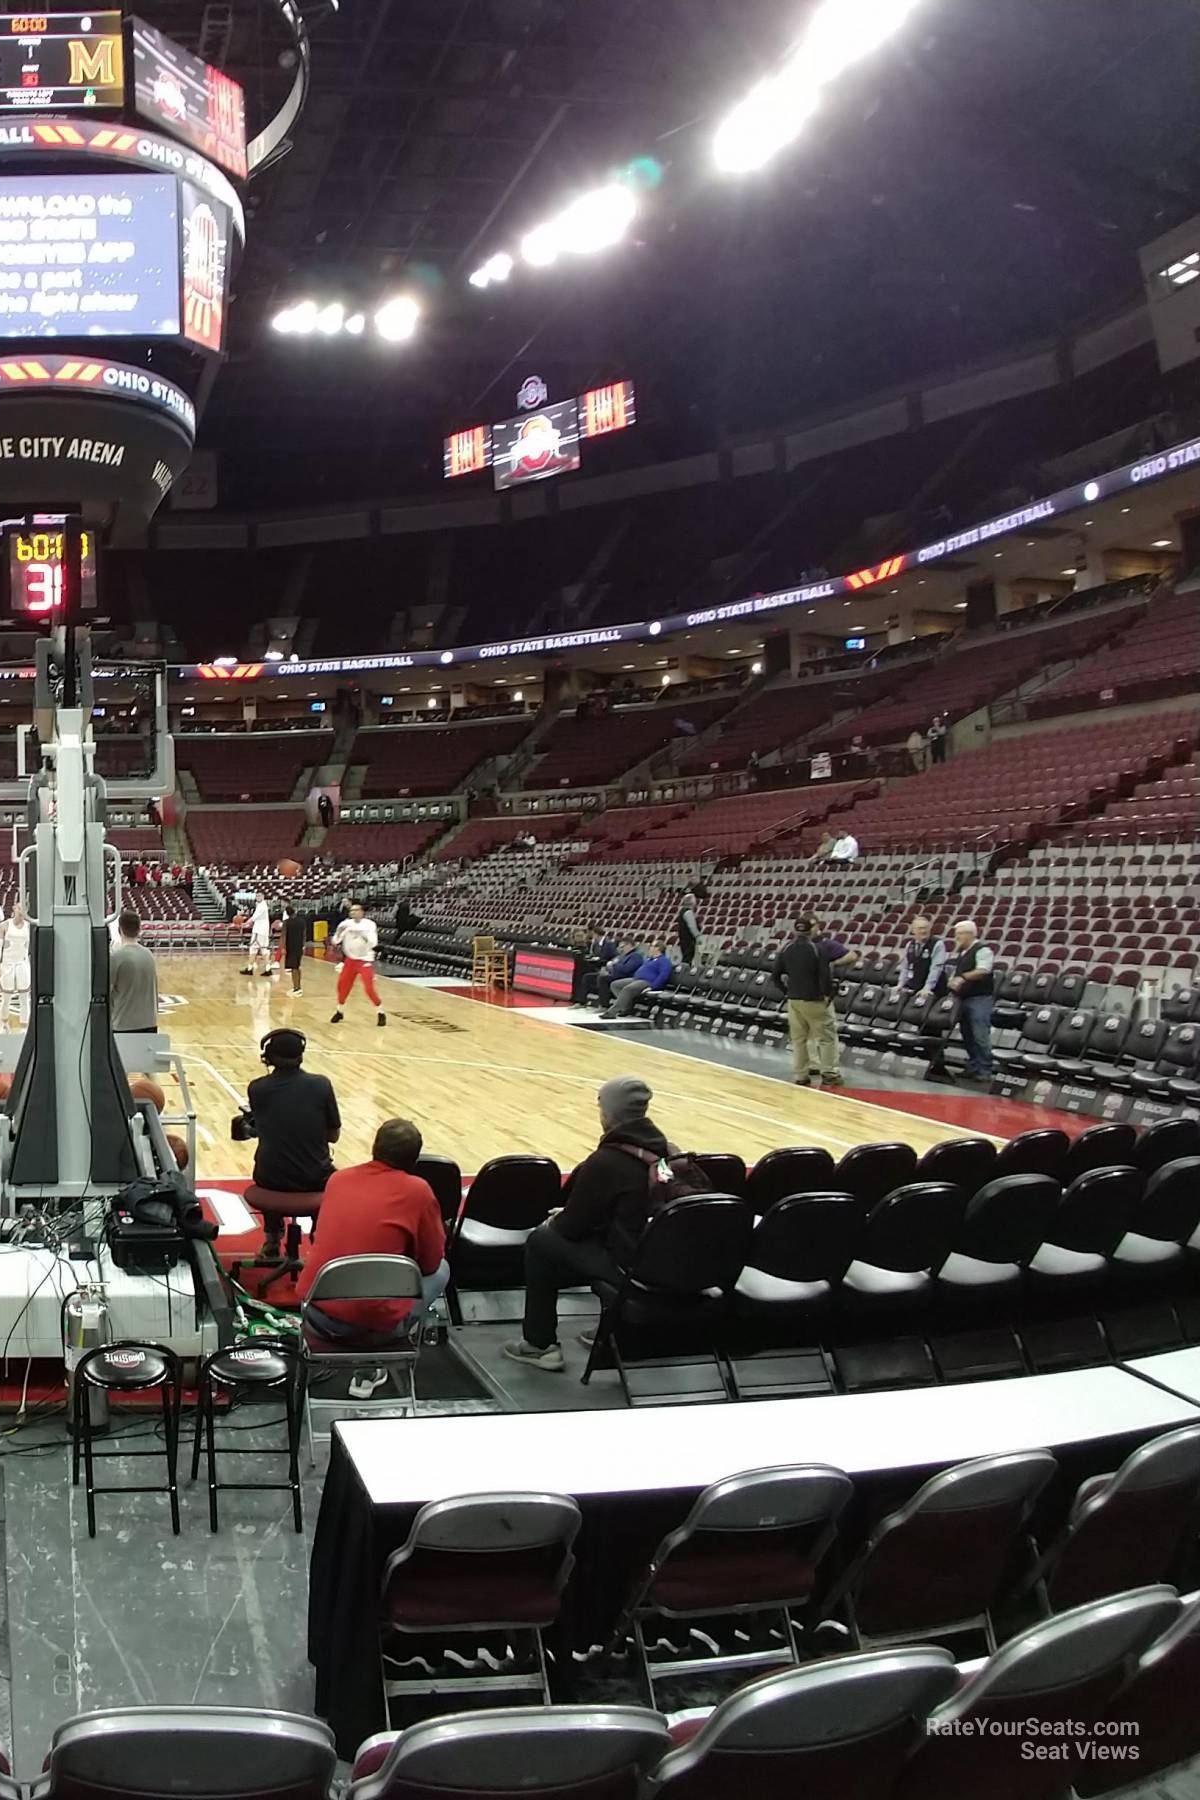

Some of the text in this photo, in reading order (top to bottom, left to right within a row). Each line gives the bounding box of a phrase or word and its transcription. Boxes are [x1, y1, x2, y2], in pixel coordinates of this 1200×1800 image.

[136, 139, 184, 168] OHIO
[103, 367, 150, 393] OHIO
[19, 437, 64, 459] CITY
[66, 438, 125, 467] ARENA
[1130, 459, 1166, 483] OHIO
[917, 542, 946, 562] OHIO
[979, 501, 1055, 540] BASKETBALL
[687, 583, 834, 626] OHIO STATE BASKETBALL
[479, 629, 622, 658] OHIO STATE BASKETBALL
[278, 656, 413, 675] OHIO STATE BASKETBALL
